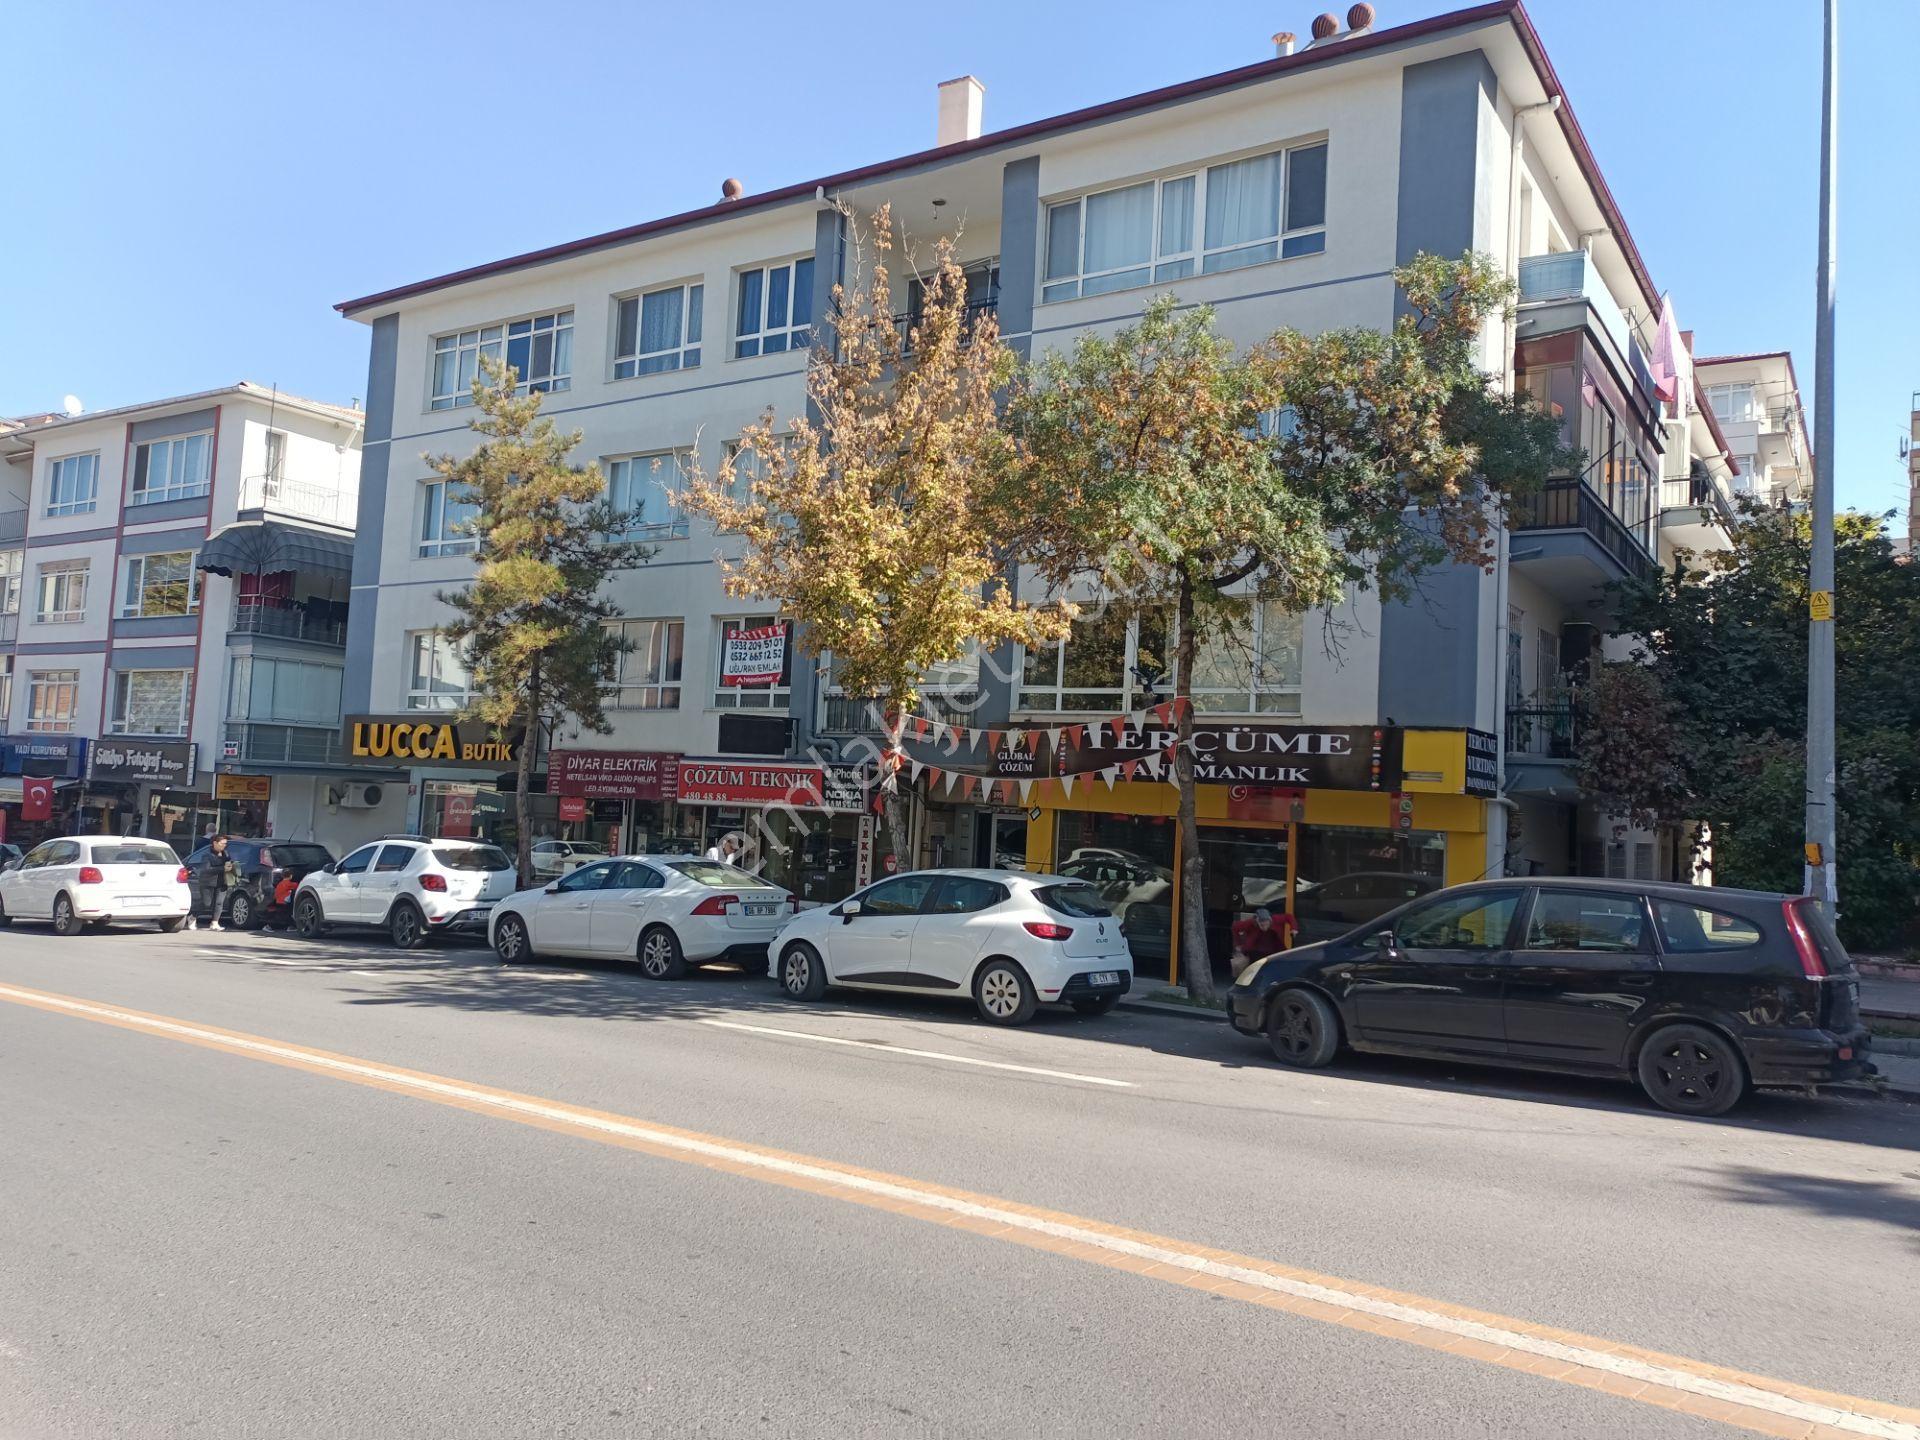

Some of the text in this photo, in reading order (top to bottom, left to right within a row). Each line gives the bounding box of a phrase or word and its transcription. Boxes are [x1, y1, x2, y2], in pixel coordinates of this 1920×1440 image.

[730, 626, 784, 640] SATILIK
[748, 641, 762, 650] 209
[764, 650, 772, 659] 12
[773, 649, 782, 658] 52
[353, 722, 456, 760] LUCCA
[1083, 727, 1352, 756] TERCÜME
[1468, 734, 1497, 754] TERCÜME
[997, 752, 1036, 761] GLOBAL
[1200, 753, 1216, 762] &
[567, 755, 658, 772] DİYAR ELEKTRİK
[999, 761, 1033, 773] ÇÖZÜM
[684, 765, 744, 787] ÇÖZÜM
[750, 769, 816, 789] TEKNİK
[834, 768, 862, 779] iPhone
[826, 790, 862, 800] NOKIA
[859, 818, 870, 886] TEKNİK
